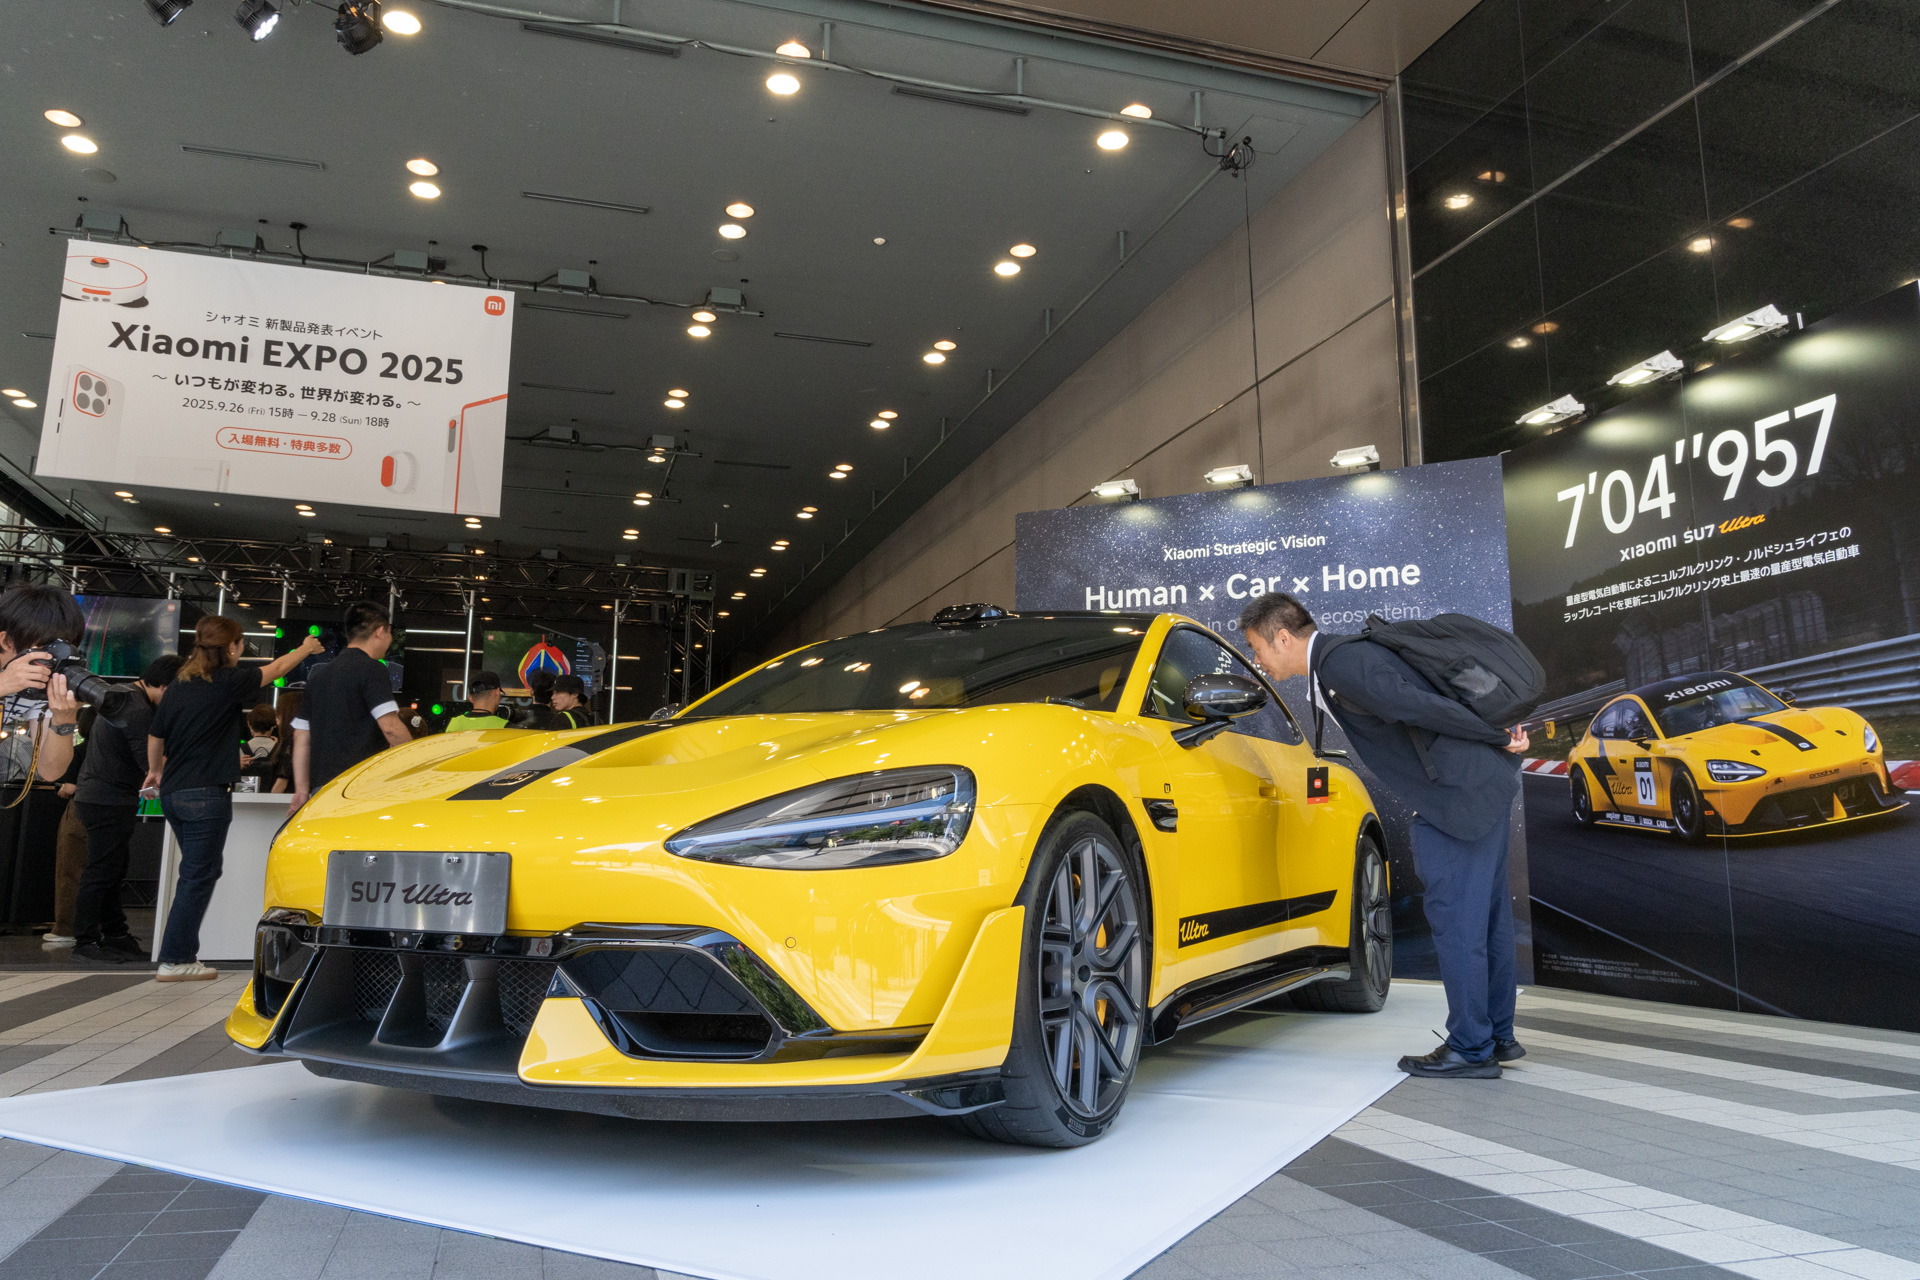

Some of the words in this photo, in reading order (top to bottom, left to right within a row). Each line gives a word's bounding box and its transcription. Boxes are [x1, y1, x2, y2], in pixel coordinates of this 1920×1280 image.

[205, 311, 260, 328] シャオミ
[265, 317, 383, 341] 新製品発表イベント
[107, 321, 250, 364] Xiaomi
[263, 339, 368, 375] EXPO
[379, 352, 463, 385] 2025
[182, 397, 245, 414] 2025.9.26
[247, 406, 266, 416] (Fri)
[268, 407, 294, 419] 15時
[310, 411, 337, 423] 9.28
[339, 416, 363, 426] (Sun)
[365, 416, 390, 429] 18時
[228, 433, 341, 454] 入場無料・特典多数
[1683, 524, 1716, 544] SU7
[1718, 513, 1766, 534] Ultra
[1163, 545, 1210, 562] Xiaomi
[1213, 538, 1277, 557] Strategic
[1281, 535, 1327, 550] Vision
[1085, 583, 1187, 610] Human
[1226, 573, 1281, 600] Car
[1323, 564, 1421, 592] Home
[1207, 618, 1221, 632] in
[1611, 781, 1633, 795] Ultra
[1639, 776, 1653, 800] 01
[350, 879, 396, 904] SU7
[401, 882, 474, 907] Ultra
[1179, 917, 1210, 942] Ultra
